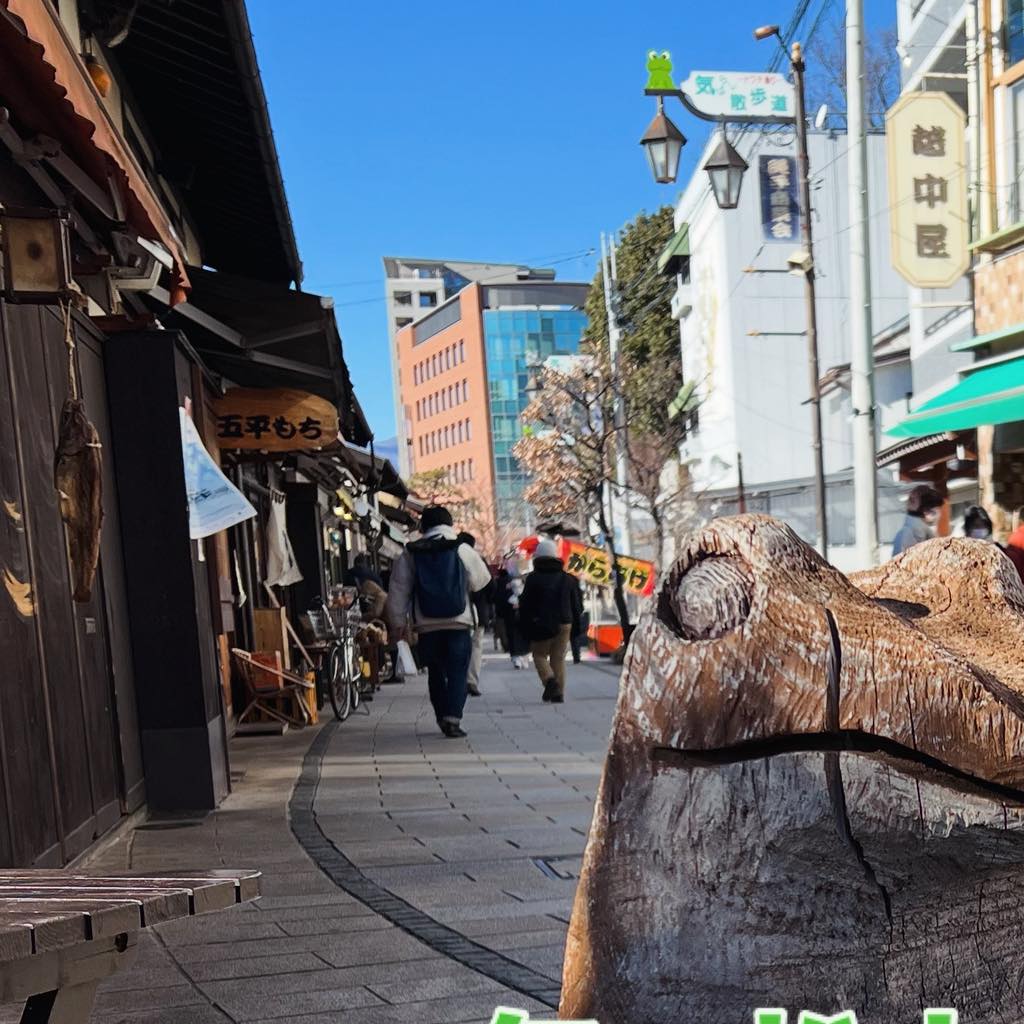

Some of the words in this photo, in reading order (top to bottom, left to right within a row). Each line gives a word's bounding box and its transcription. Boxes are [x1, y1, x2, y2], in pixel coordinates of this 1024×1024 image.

[912, 124, 950, 259] 越中屋
[217, 414, 323, 440] 五平もち
[567, 551, 651, 590] からげ
